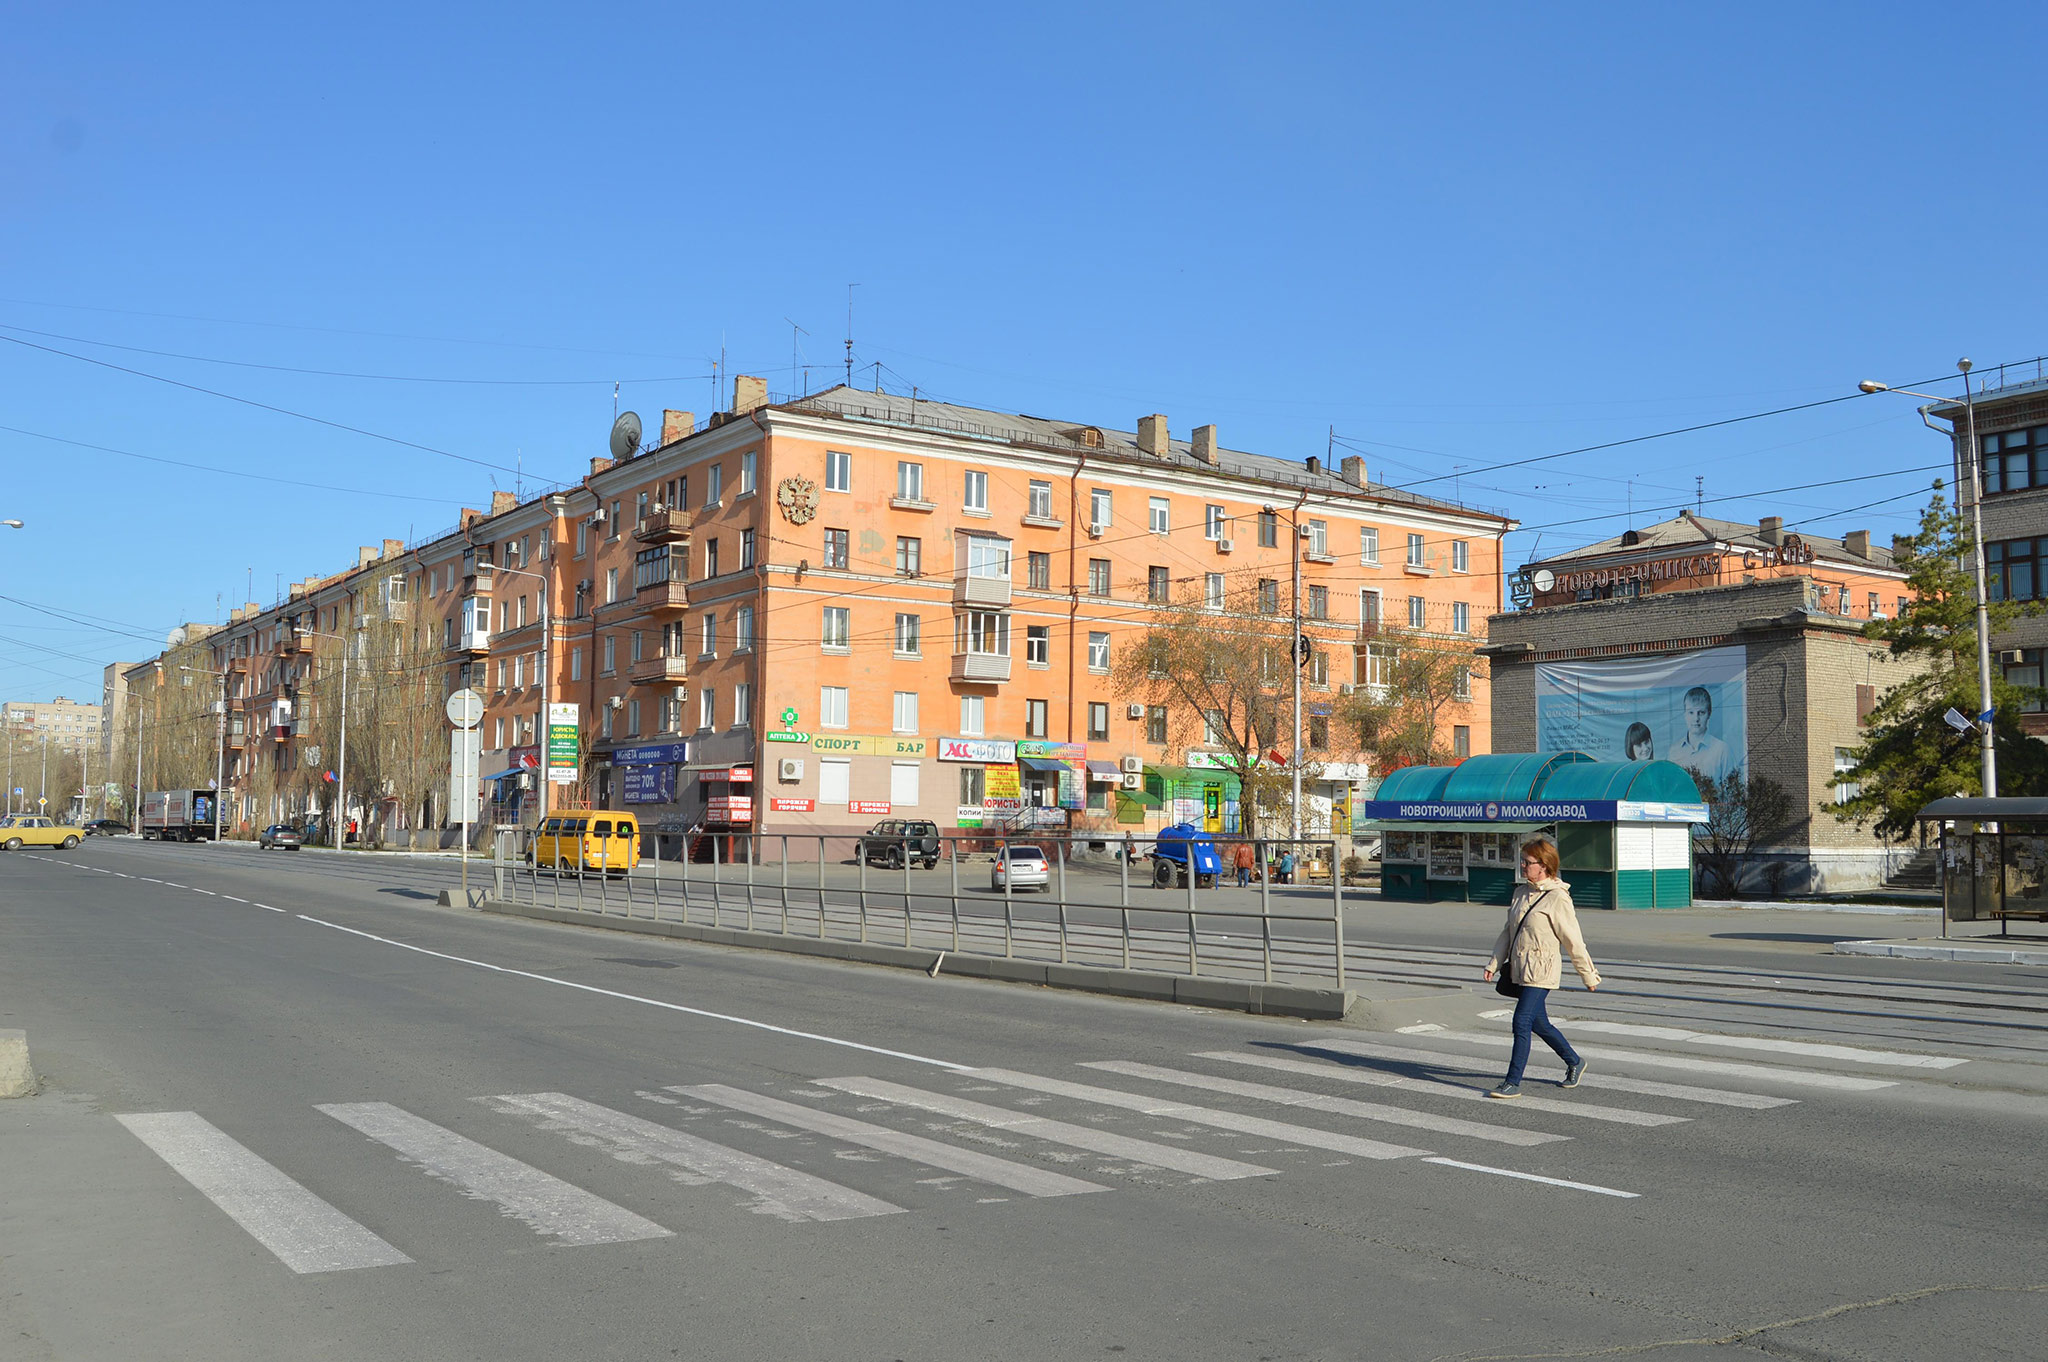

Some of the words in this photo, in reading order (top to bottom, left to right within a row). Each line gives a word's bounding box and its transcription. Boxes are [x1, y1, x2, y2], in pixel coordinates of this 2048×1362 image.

[1742, 542, 1817, 570] СТАЛЬ
[769, 731, 796, 741] АПТЕКА
[814, 738, 861, 750] СПОРТ
[896, 742, 924, 753] БАР
[1207, 755, 1256, 767] АПТЕА
[641, 774, 655, 788] 70%
[984, 798, 1021, 809] ЮРИСТЫ
[1400, 803, 1483, 819] НОВОТРОИЦКИЙ
[1501, 804, 1588, 819] МОЛОКОЗАВОД
